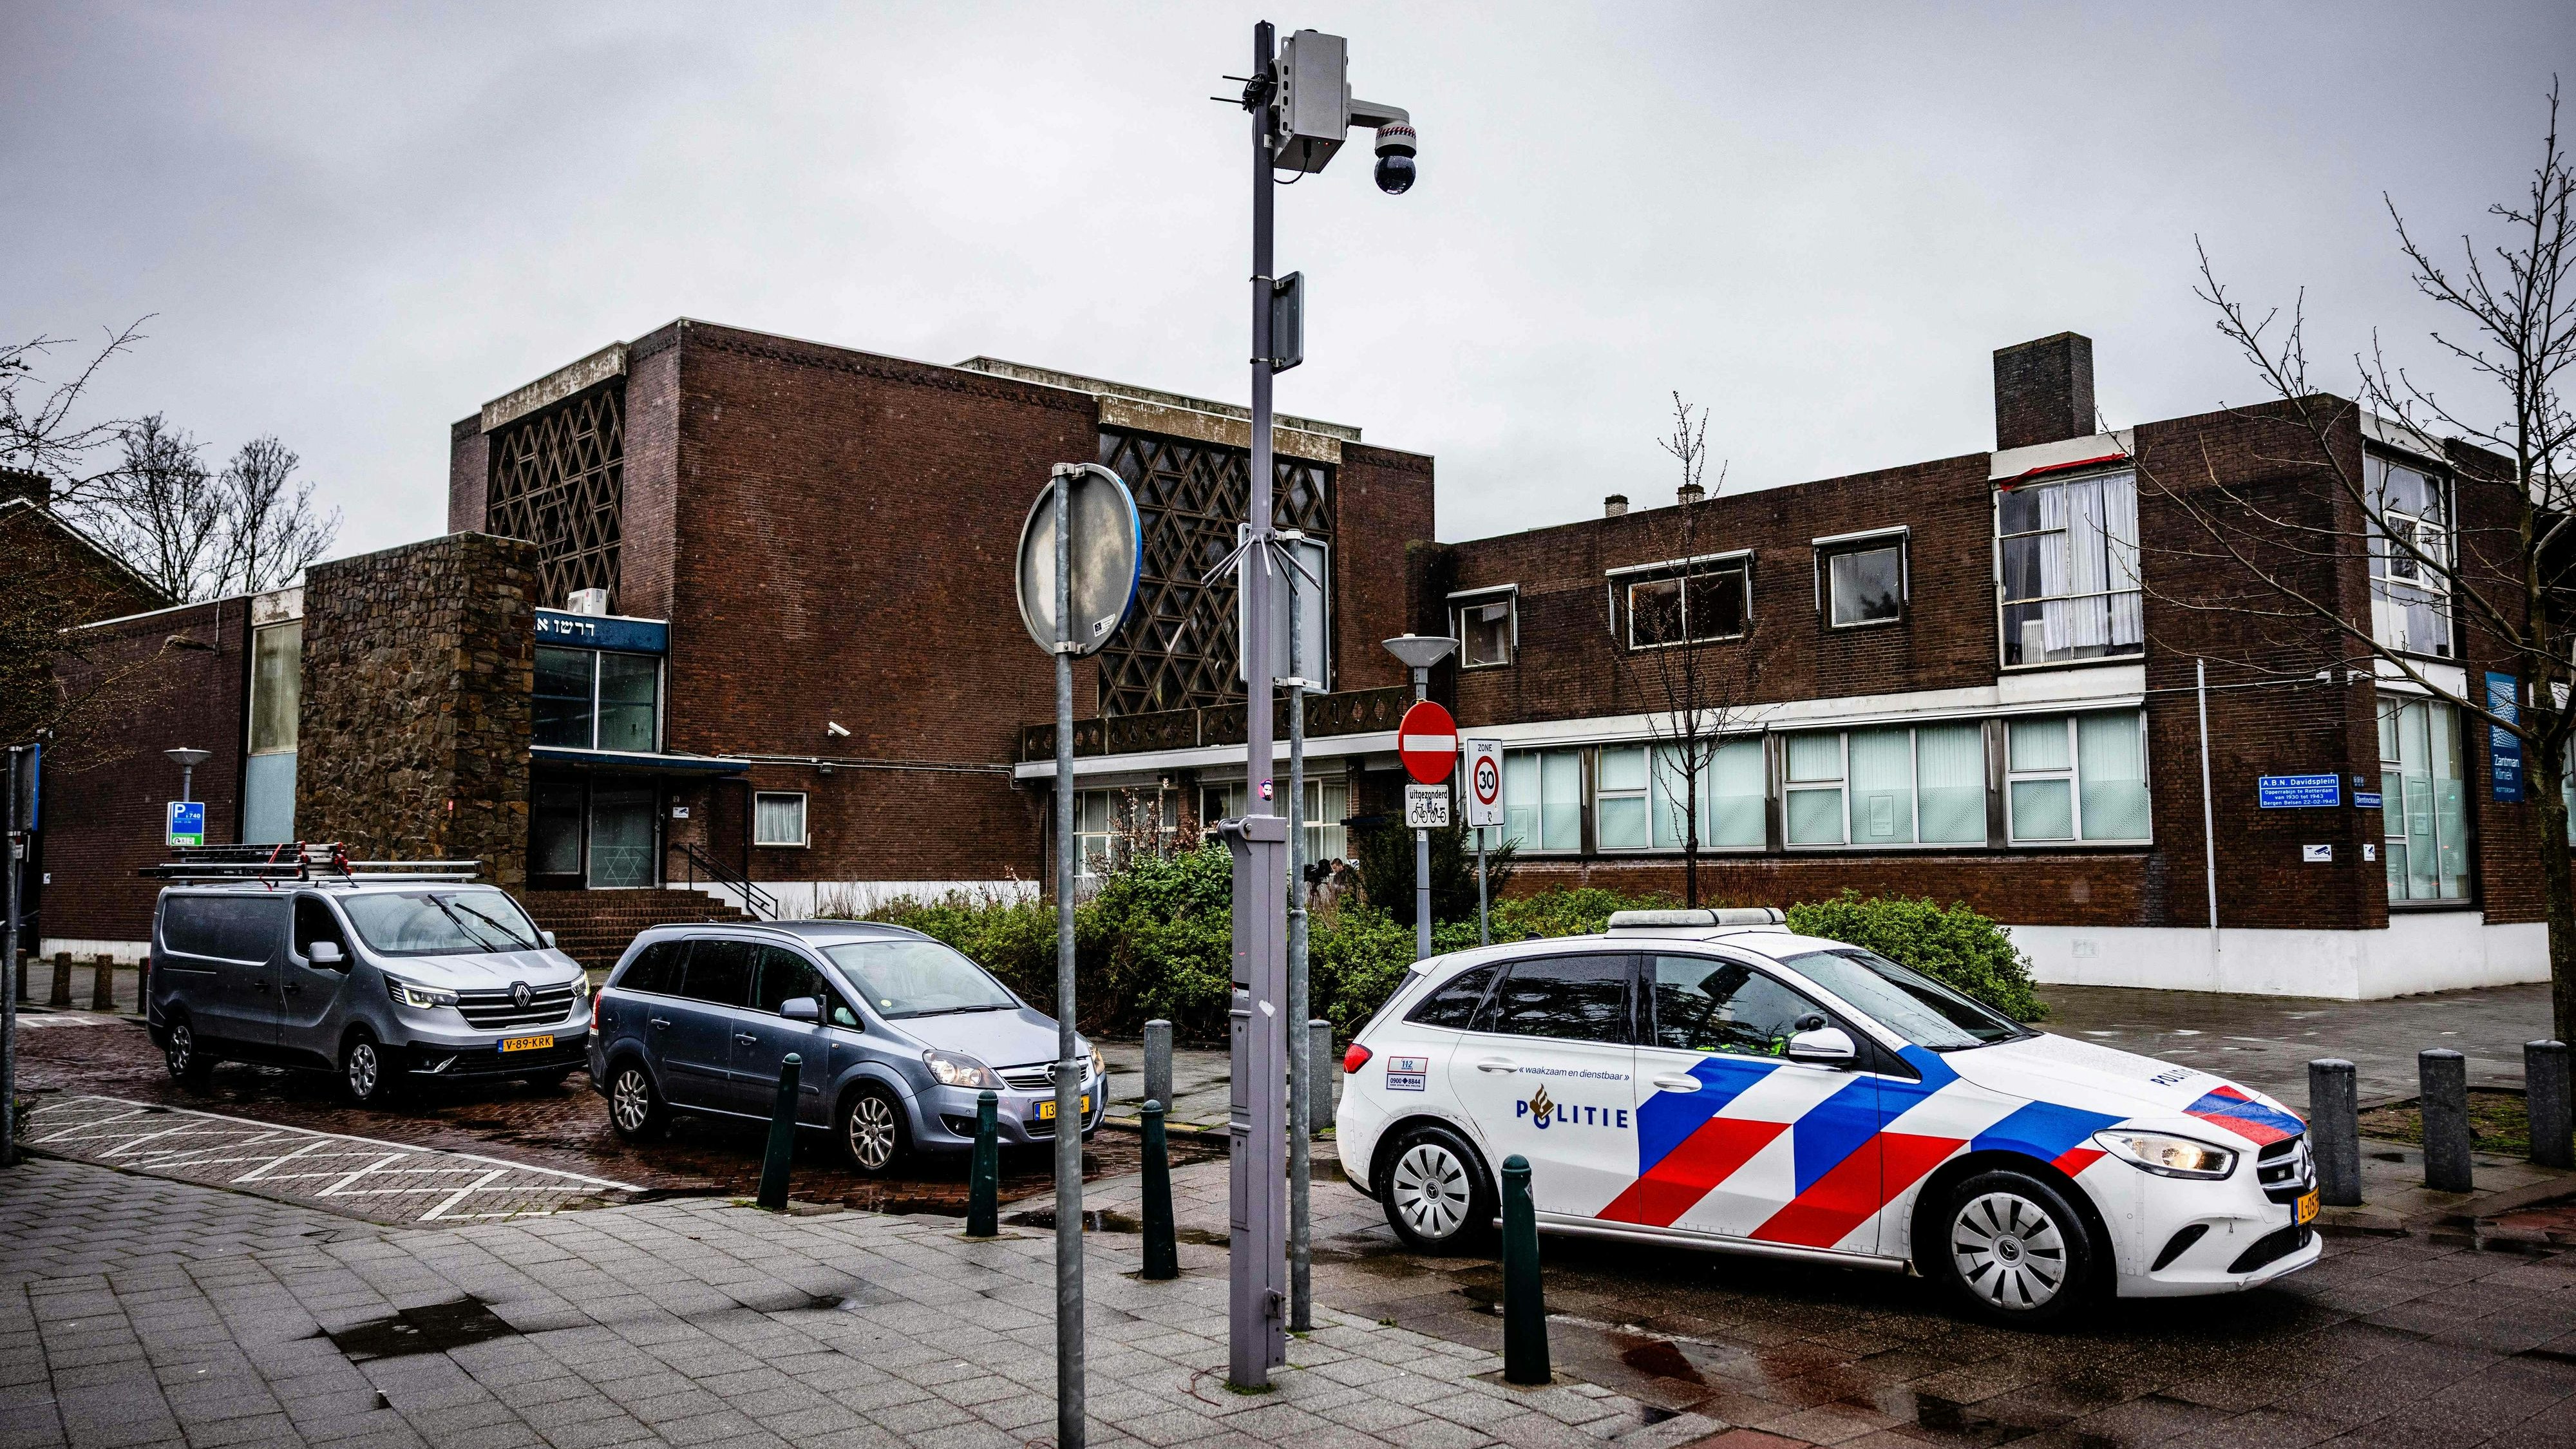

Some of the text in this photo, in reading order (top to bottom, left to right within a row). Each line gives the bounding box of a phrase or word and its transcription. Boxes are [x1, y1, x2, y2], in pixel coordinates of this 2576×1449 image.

[554, 619, 595, 637] דרשו
[1478, 744, 1493, 752] ZONE
[2494, 754, 2520, 768] Zantman
[1479, 770, 1495, 790] 30
[1409, 789, 1448, 802] uitgezonderd
[174, 804, 186, 818] P
[506, 1036, 551, 1050] V-89-KRK
[1525, 1066, 1567, 1076] waakzaam
[1579, 1069, 1623, 1081] dienstbaar
[1516, 1099, 1628, 1129] POLITIE
